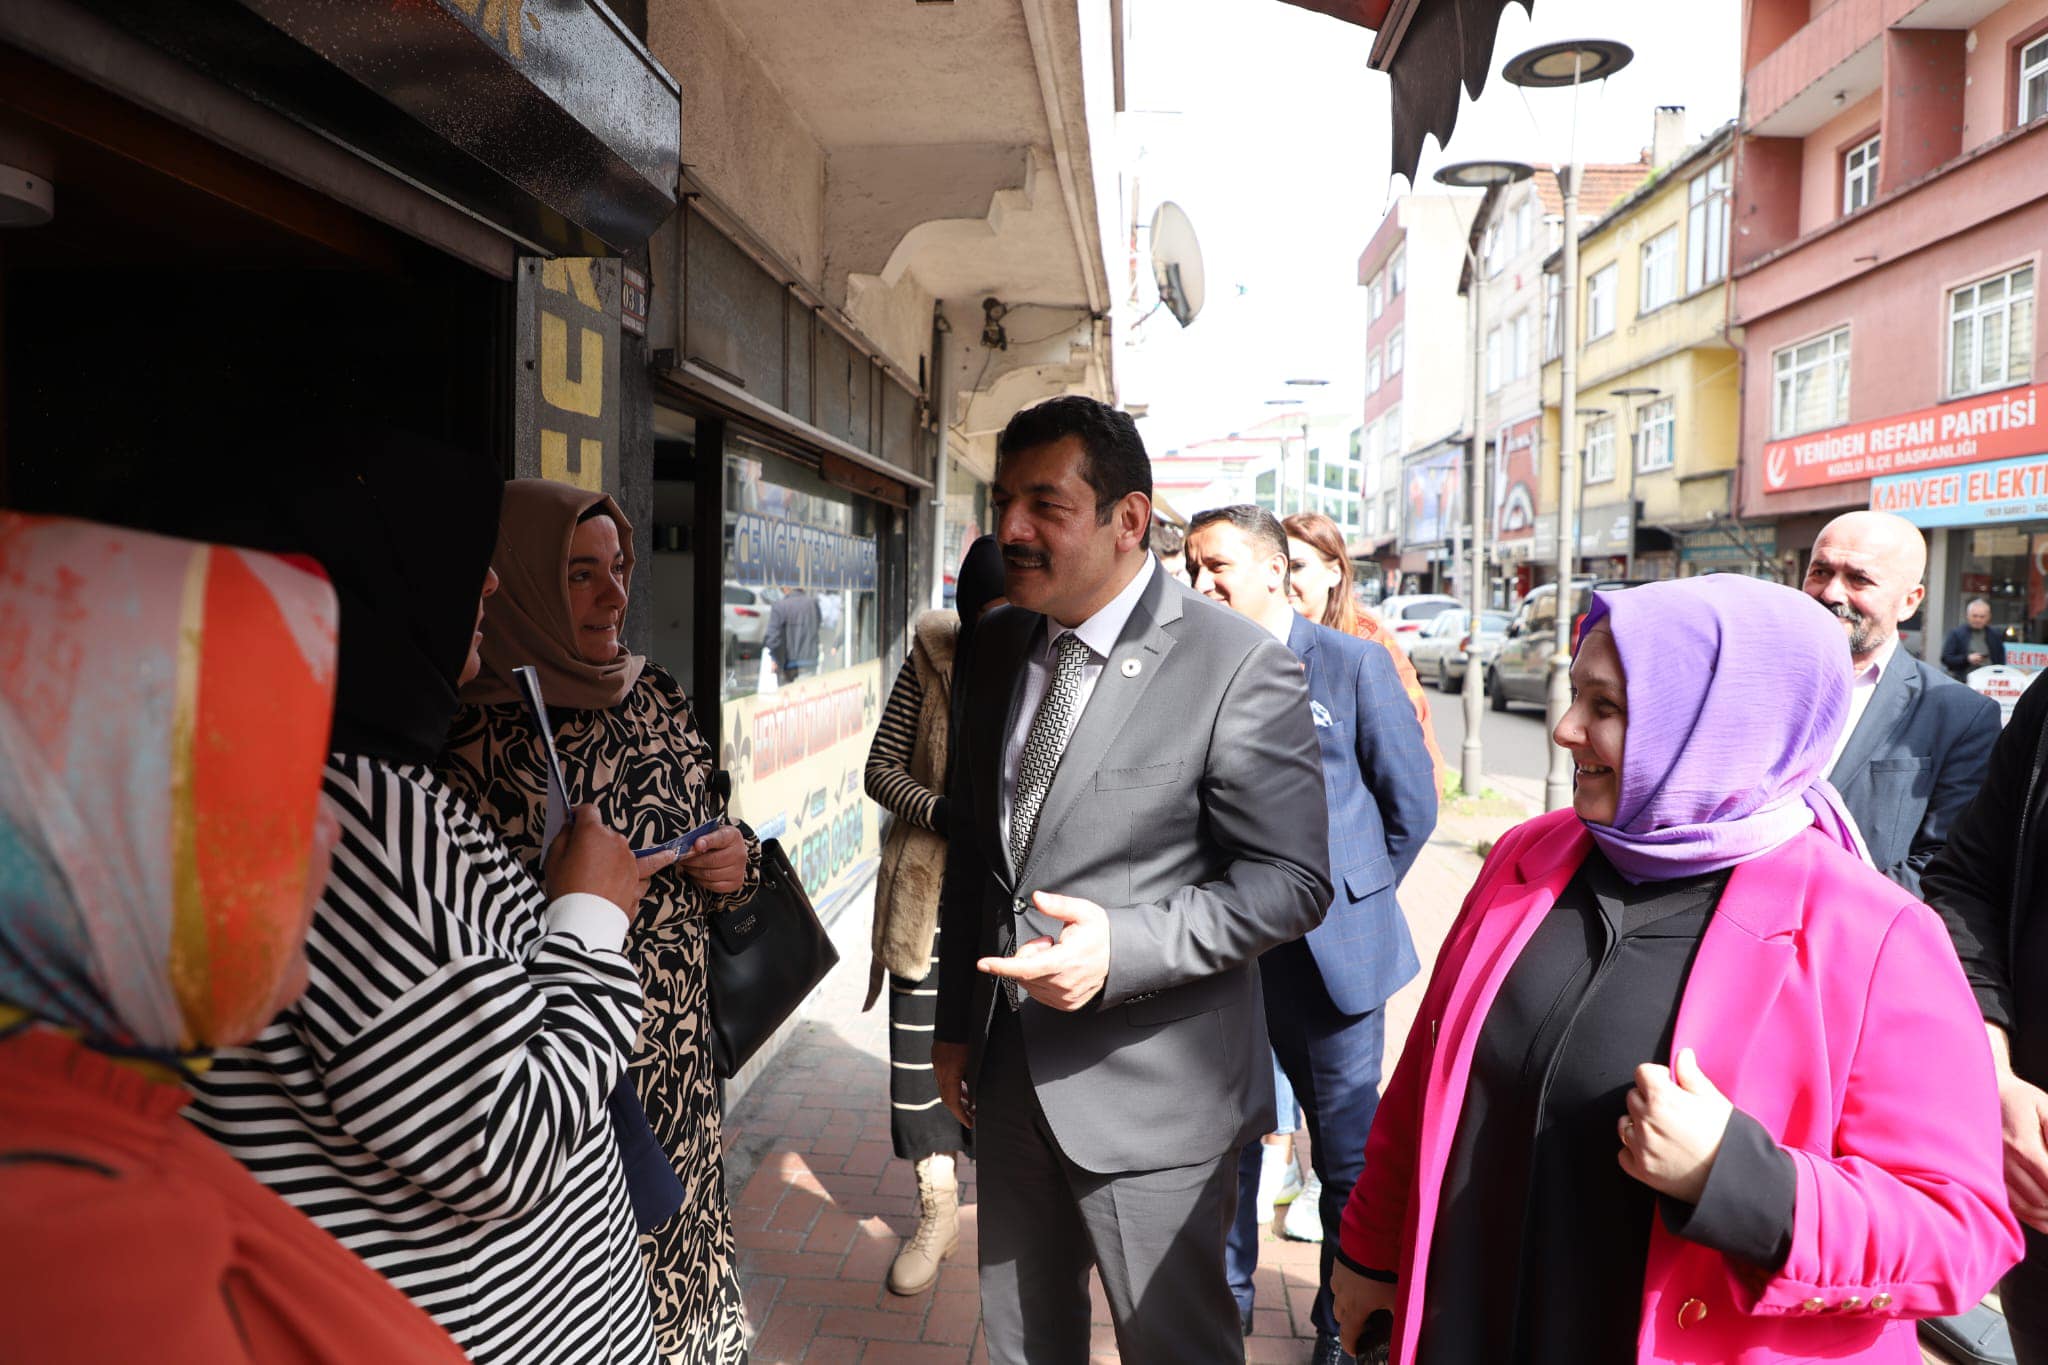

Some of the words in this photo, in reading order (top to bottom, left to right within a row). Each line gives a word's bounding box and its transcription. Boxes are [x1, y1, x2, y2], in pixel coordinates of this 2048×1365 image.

[1793, 432, 1866, 467] YENİDEN
[1871, 418, 1935, 450] REFAH
[1942, 390, 2036, 441] PARTİSİ
[1895, 438, 1978, 466] BAŞKANLIĞI
[1872, 473, 1961, 511] KAHVECİ
[734, 508, 802, 587] CENGİZ
